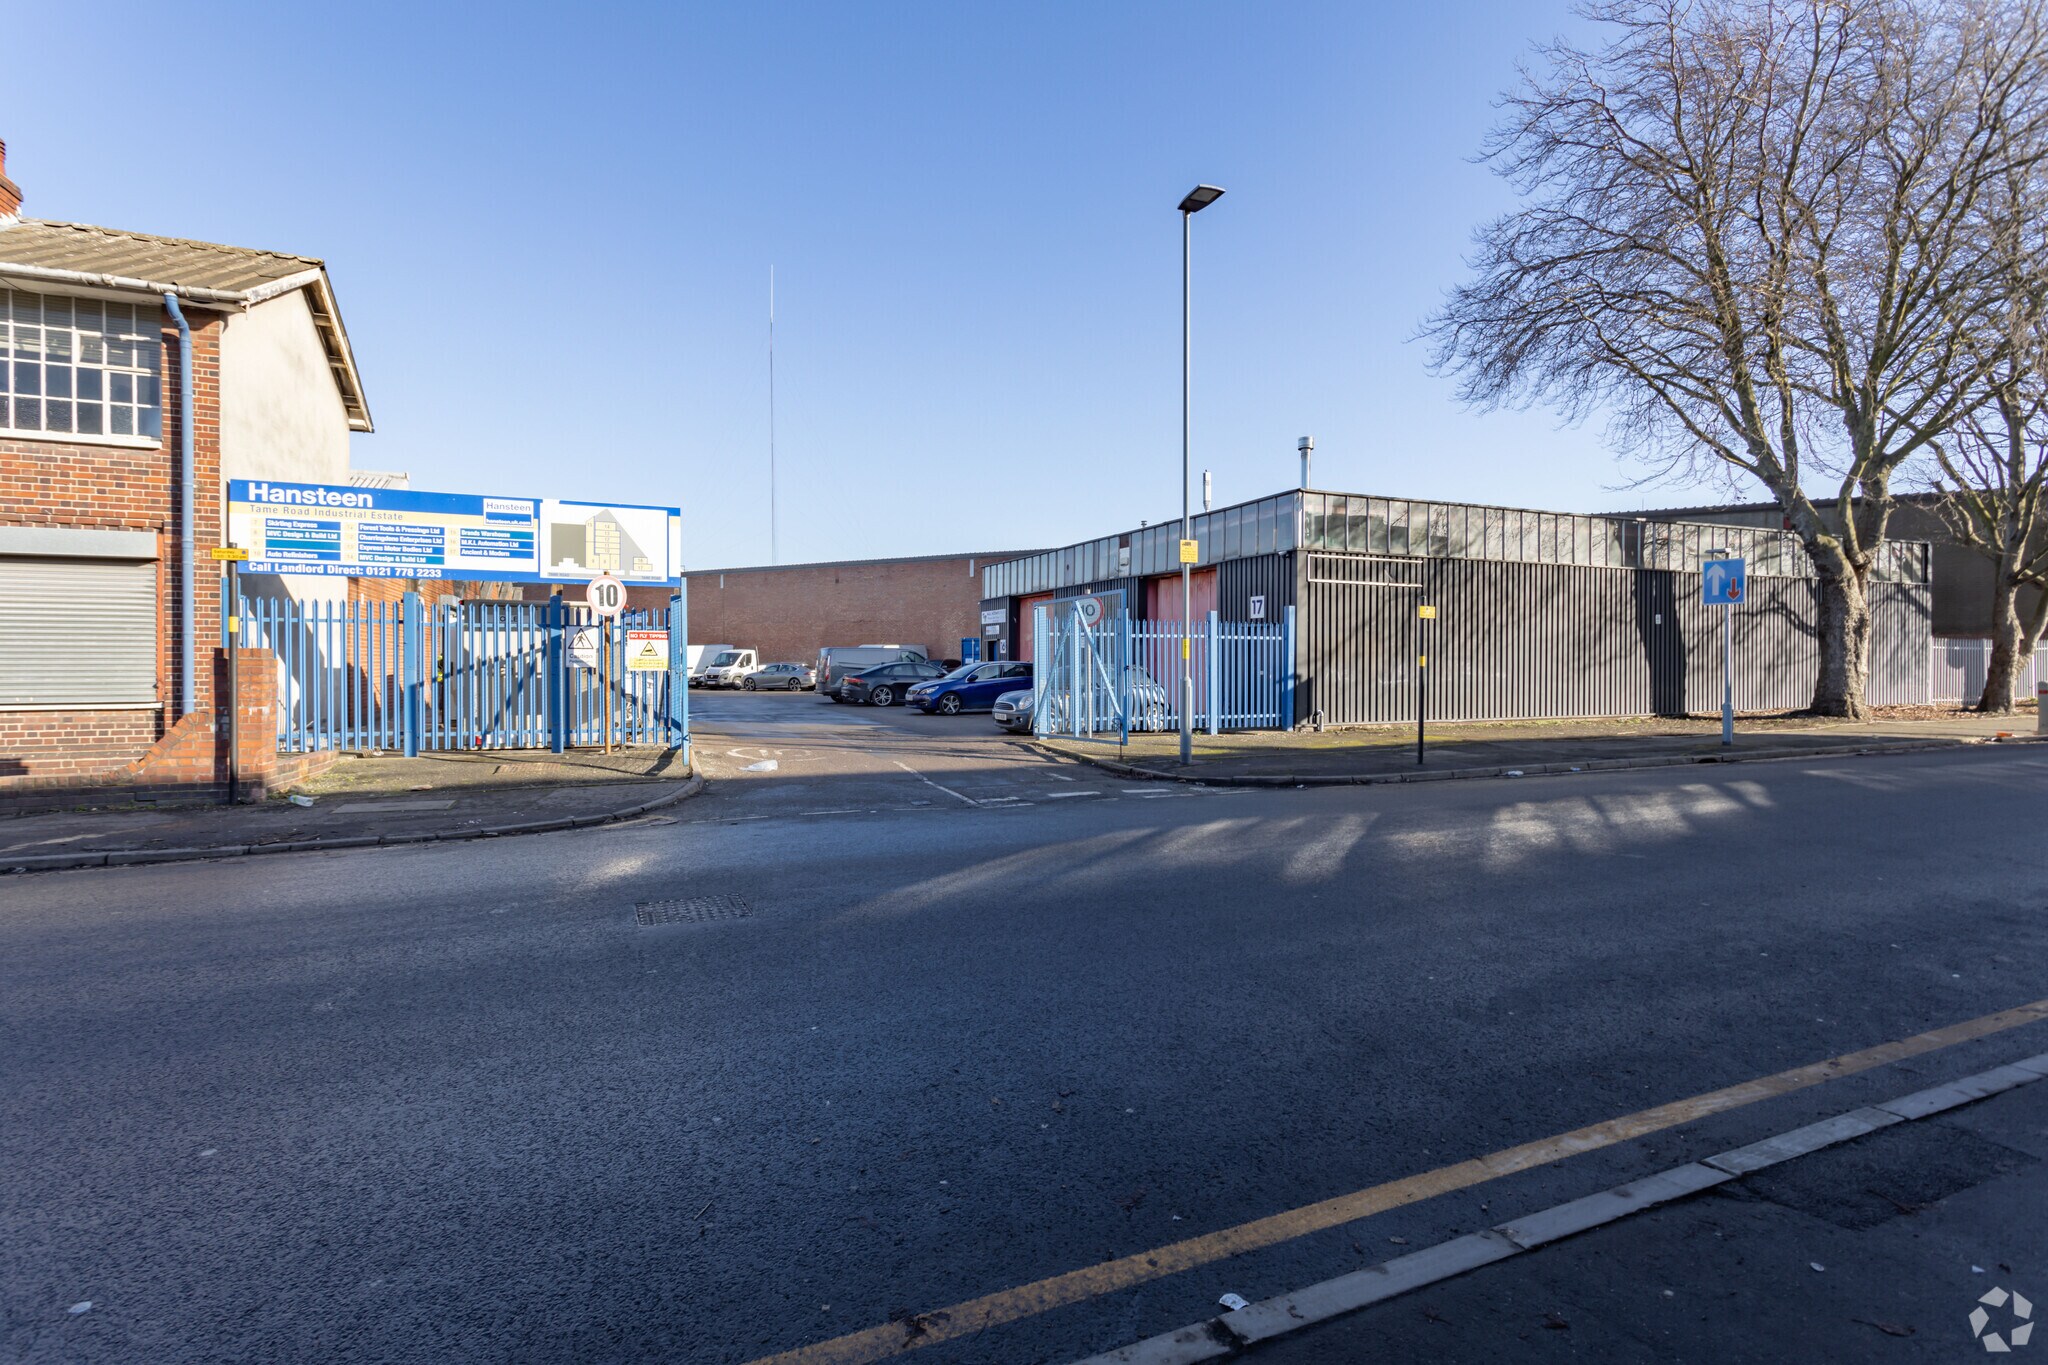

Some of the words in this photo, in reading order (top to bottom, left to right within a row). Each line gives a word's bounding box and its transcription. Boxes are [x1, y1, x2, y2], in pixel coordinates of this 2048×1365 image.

[248, 482, 373, 508] Hansteen
[250, 504, 278, 514] Tame
[283, 506, 310, 516] Road
[314, 508, 366, 518] Industrial
[371, 511, 403, 520] Estate
[486, 501, 531, 511] Hansteen
[293, 521, 318, 529] Express
[359, 544, 383, 552] Express
[248, 562, 271, 571] Call
[274, 563, 324, 574] Landlord
[327, 565, 364, 575] Direct:
[366, 567, 391, 576] 0121
[394, 567, 414, 577] 778
[416, 568, 442, 578] 2233
[595, 584, 618, 607] 10
[1252, 600, 1263, 615] 17
